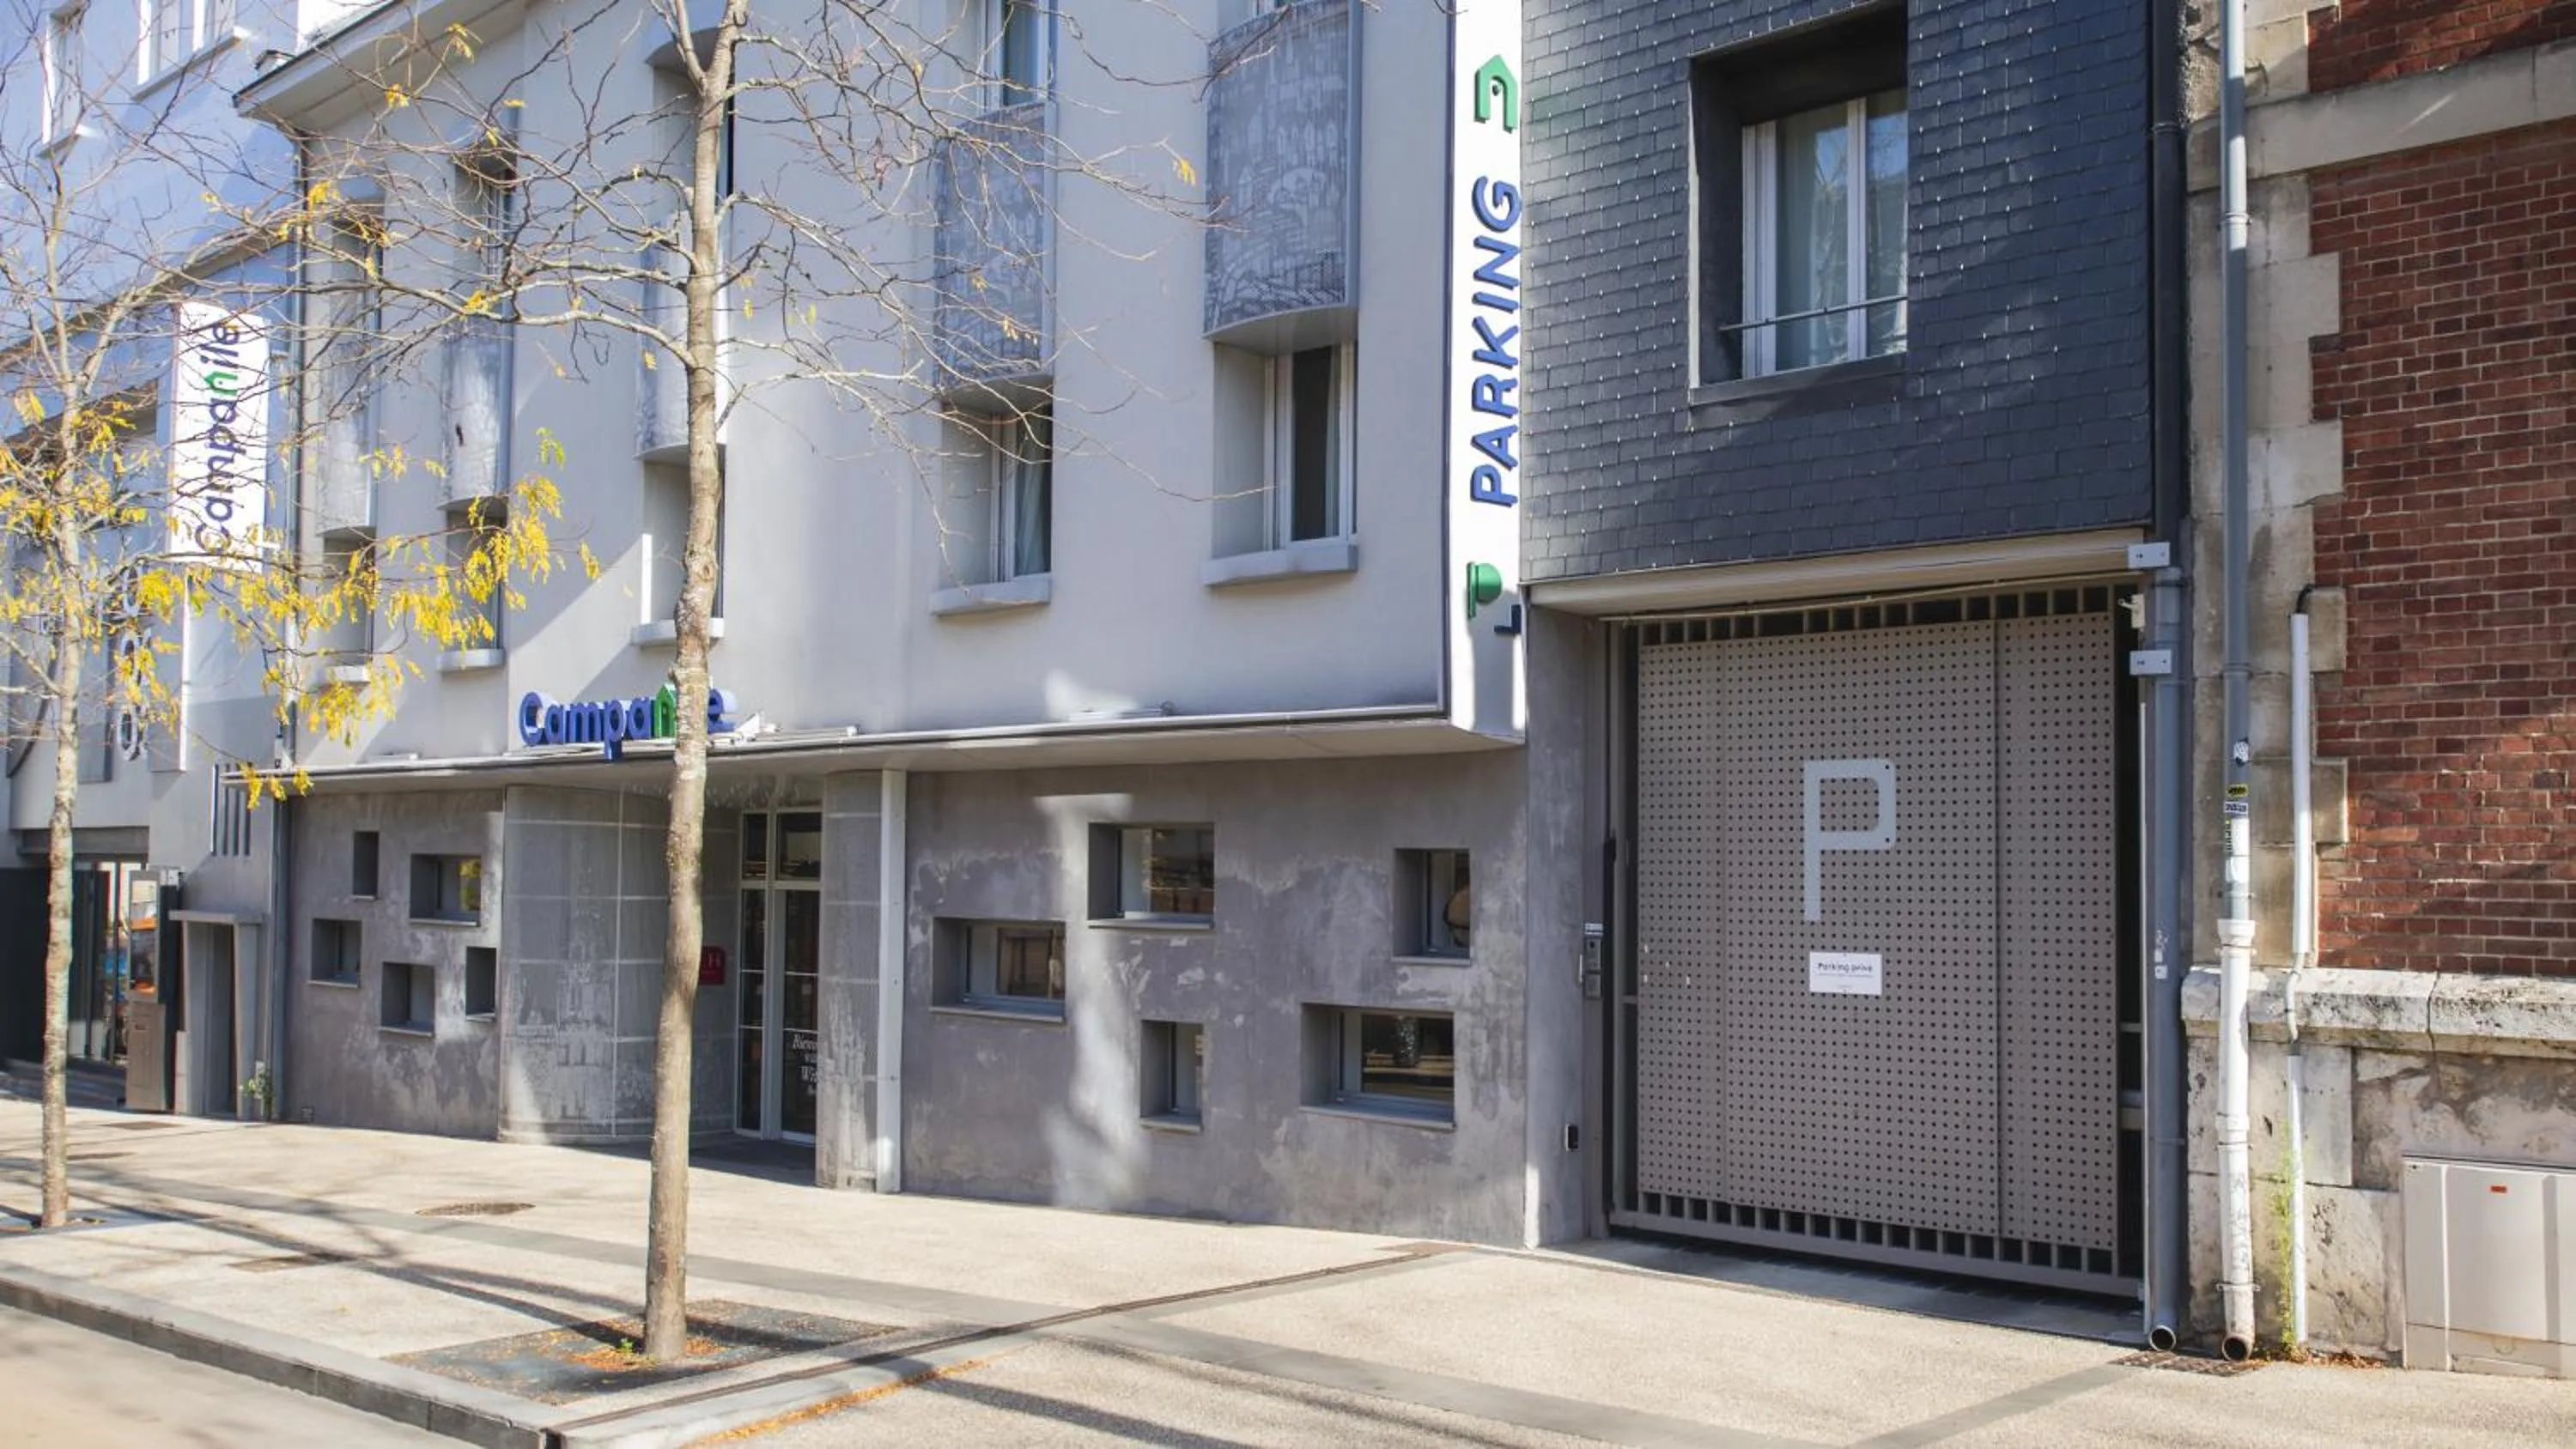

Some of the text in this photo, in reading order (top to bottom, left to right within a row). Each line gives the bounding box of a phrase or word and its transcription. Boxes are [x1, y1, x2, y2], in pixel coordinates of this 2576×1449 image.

[1470, 175, 1521, 507] PARKING
[194, 321, 246, 554] Campanile
[519, 685, 736, 761] Campane
[1804, 759, 1896, 921] P
[1818, 962, 1850, 973] Parking
